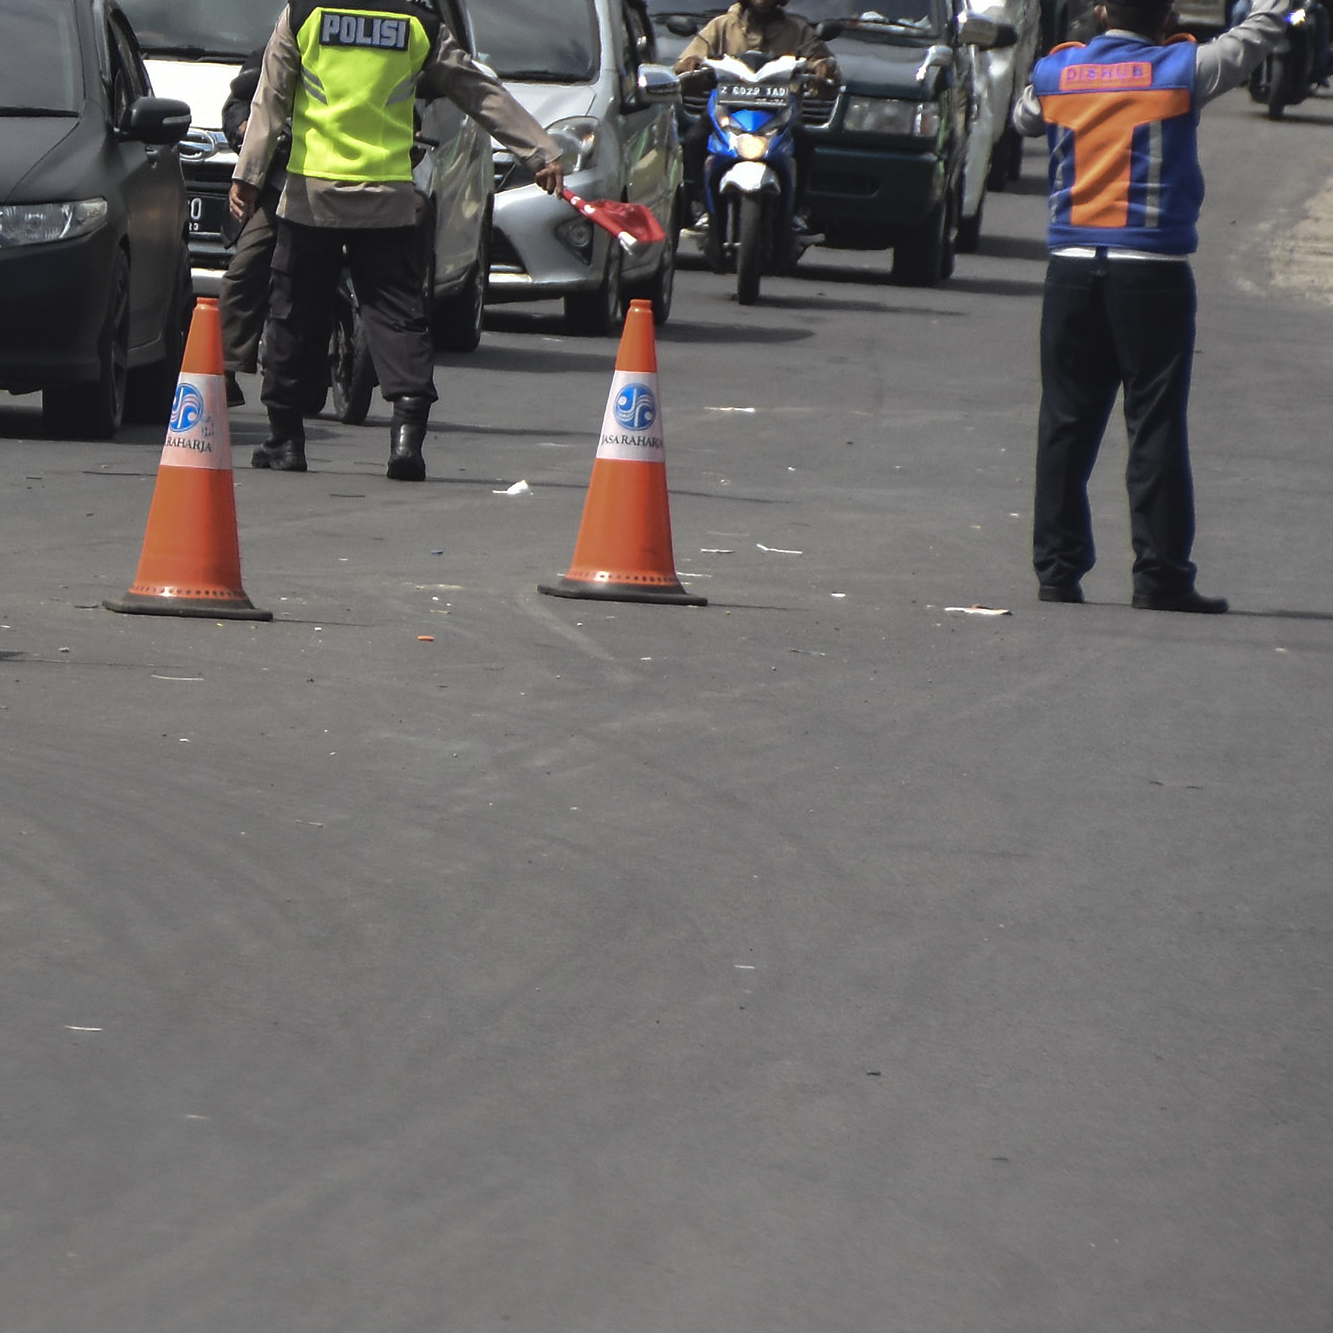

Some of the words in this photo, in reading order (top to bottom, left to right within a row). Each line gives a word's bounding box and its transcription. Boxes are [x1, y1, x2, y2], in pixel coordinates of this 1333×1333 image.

[322, 13, 407, 48] POLISI
[1067, 65, 1143, 81] DISHUB
[166, 436, 212, 453] RAHARJA
[601, 434, 620, 447] JASA
